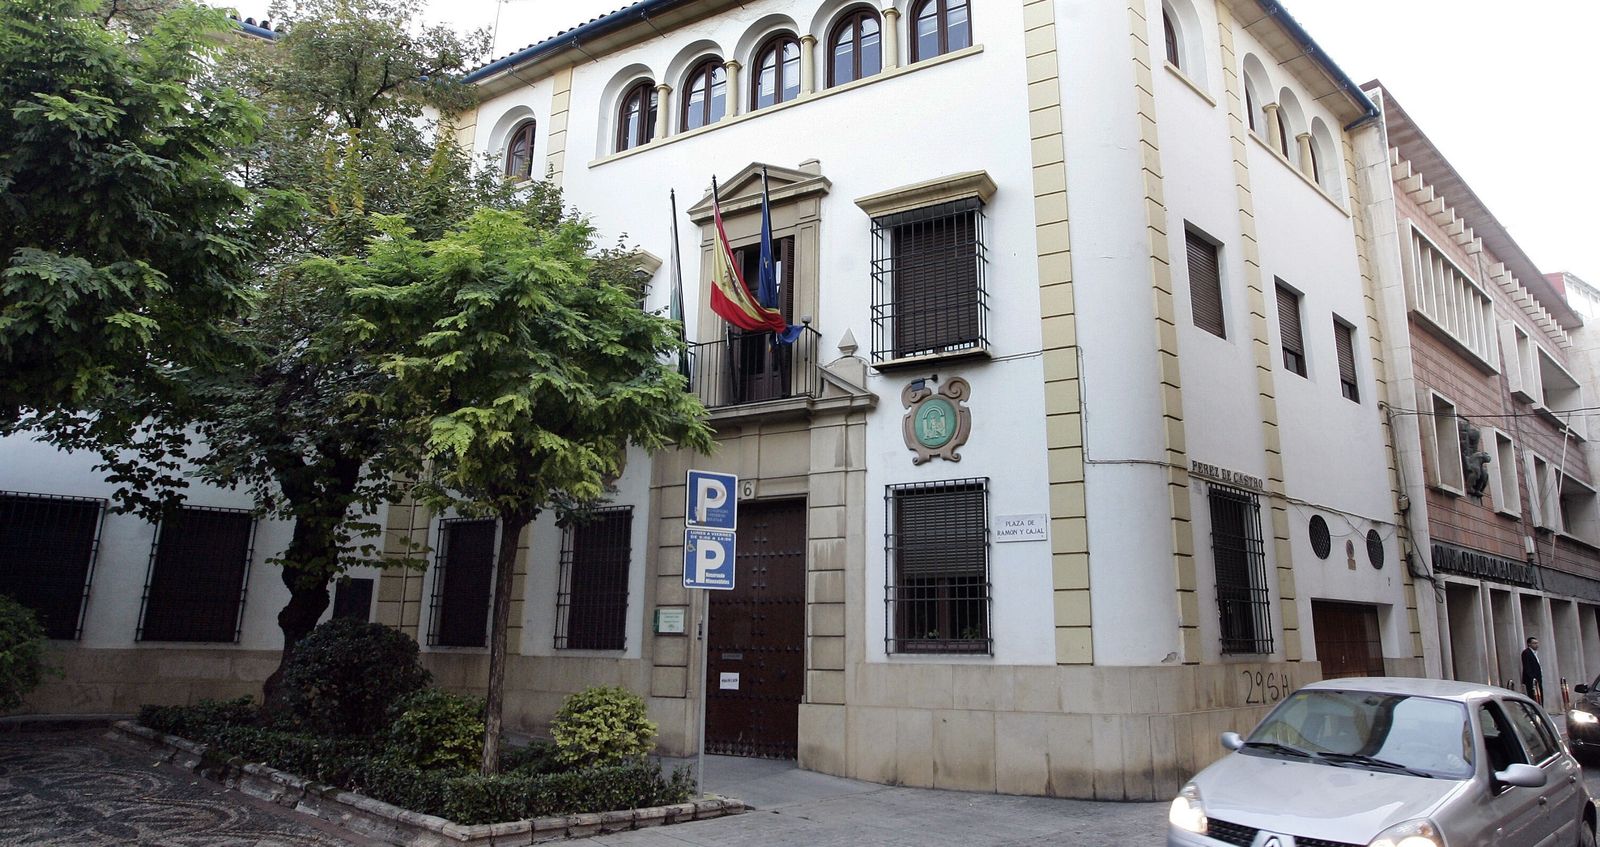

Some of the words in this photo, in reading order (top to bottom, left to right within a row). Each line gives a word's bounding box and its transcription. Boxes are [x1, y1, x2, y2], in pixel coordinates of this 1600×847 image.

[743, 481, 753, 497] 6
[1191, 460, 1219, 478] PEREZ
[1221, 468, 1232, 482] DE
[1233, 471, 1263, 489] CASTRO
[697, 477, 727, 522] P
[1025, 527, 1044, 535] CAJAL
[696, 539, 726, 584] P
